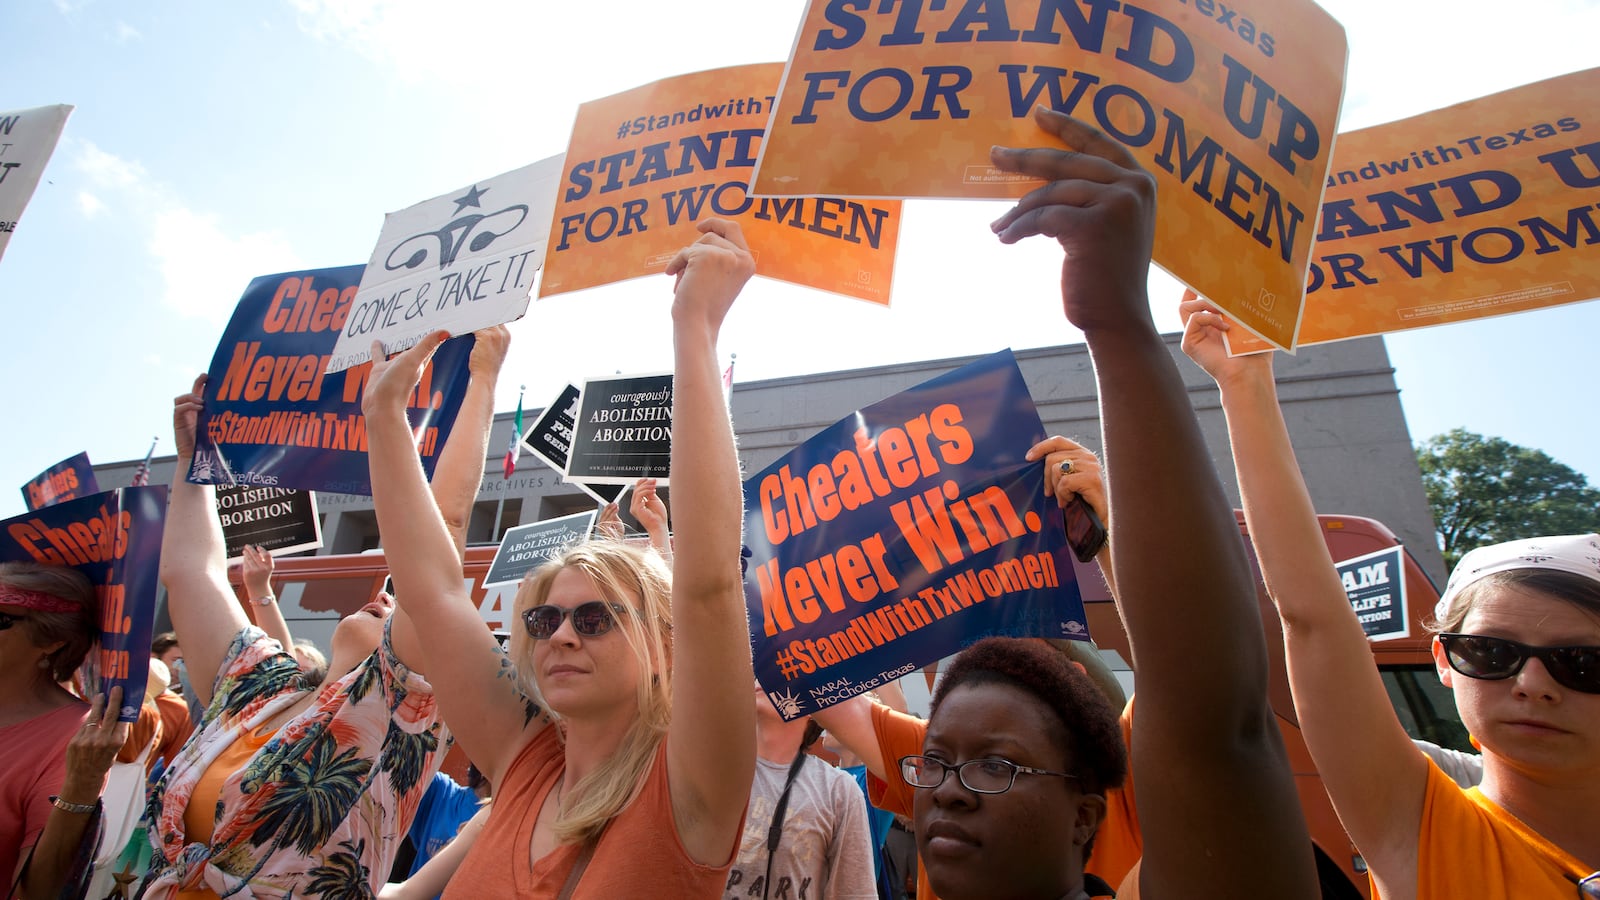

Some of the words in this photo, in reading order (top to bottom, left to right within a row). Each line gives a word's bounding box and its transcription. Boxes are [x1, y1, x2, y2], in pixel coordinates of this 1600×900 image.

[1179, 0, 1275, 58] exas
[814, 0, 1195, 83] STAND
[1222, 53, 1320, 176] UP
[565, 129, 766, 202] STAND
[792, 66, 972, 124] FOR
[999, 64, 1304, 263] WOMEN
[556, 199, 648, 252] FOR
[662, 182, 889, 250] WOMEN
[347, 288, 413, 339] COME
[404, 282, 431, 321] &
[435, 260, 501, 311] TAKE
[496, 249, 536, 294] IT.
[216, 341, 335, 402] Never
[611, 386, 671, 406] courageously
[592, 427, 672, 442] ABORTION
[247, 471, 279, 486] Texas
[760, 403, 975, 546] Cheaters
[507, 530, 578, 554] ABOLISHING
[756, 532, 900, 638] Never
[890, 480, 1042, 574] Win.
[1342, 561, 1390, 592] AM
[776, 551, 1060, 681] #StandWithTxWomen
[809, 677, 852, 698] NARAL
[816, 678, 881, 708] Pro-Choice
[879, 662, 916, 681] Texas
